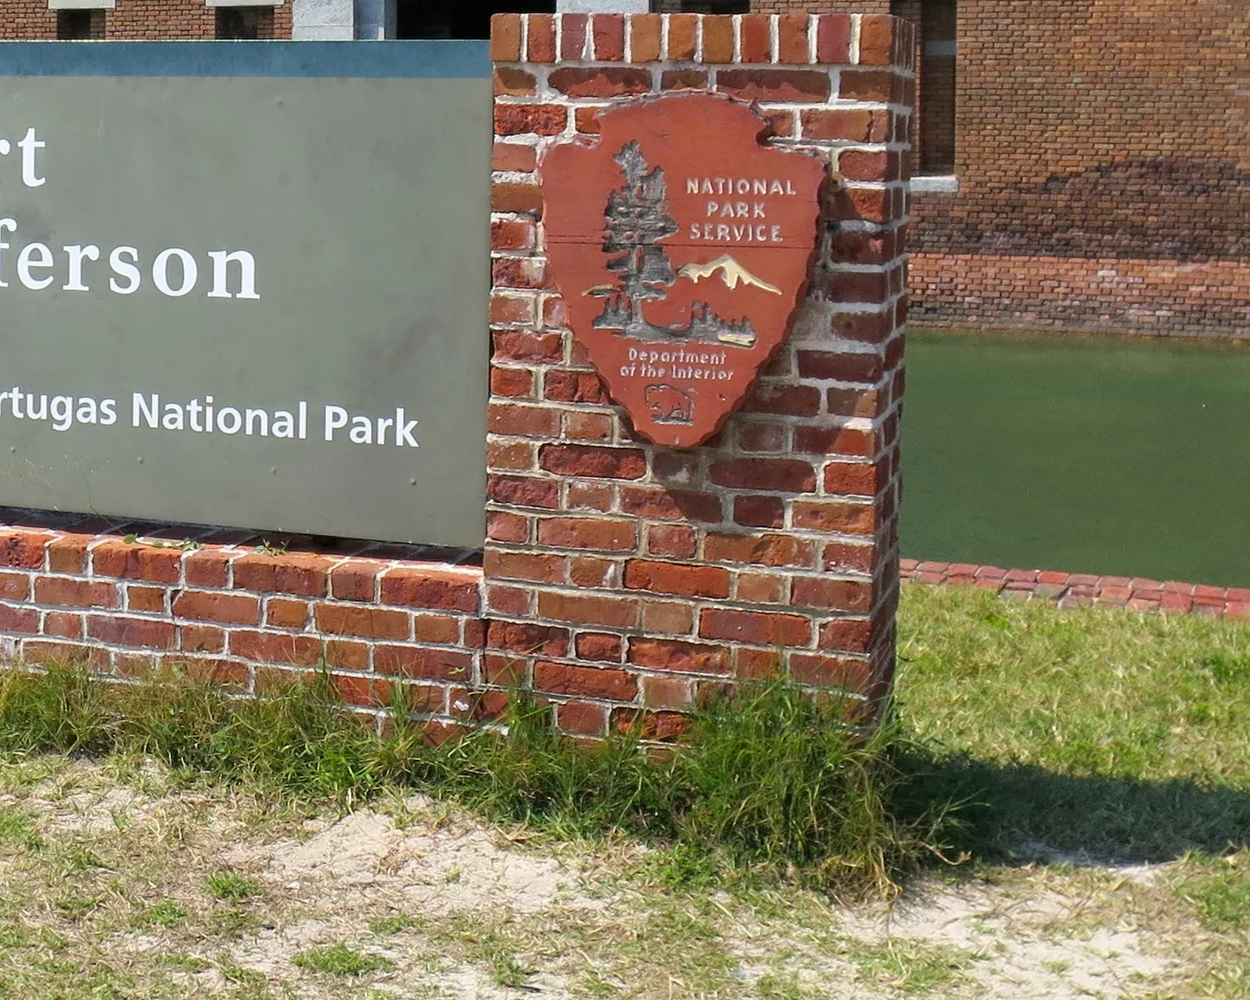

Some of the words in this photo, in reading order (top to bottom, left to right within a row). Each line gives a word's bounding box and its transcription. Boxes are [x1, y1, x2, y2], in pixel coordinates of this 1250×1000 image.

[686, 178, 797, 196] NATIONAL
[706, 201, 766, 219] PARK
[690, 223, 784, 243] SERVICE
[628, 347, 726, 365] Department
[620, 362, 636, 377] of
[640, 364, 665, 378] the
[671, 364, 734, 381] Interior
[132, 392, 307, 440] National
[324, 404, 419, 448] Park
